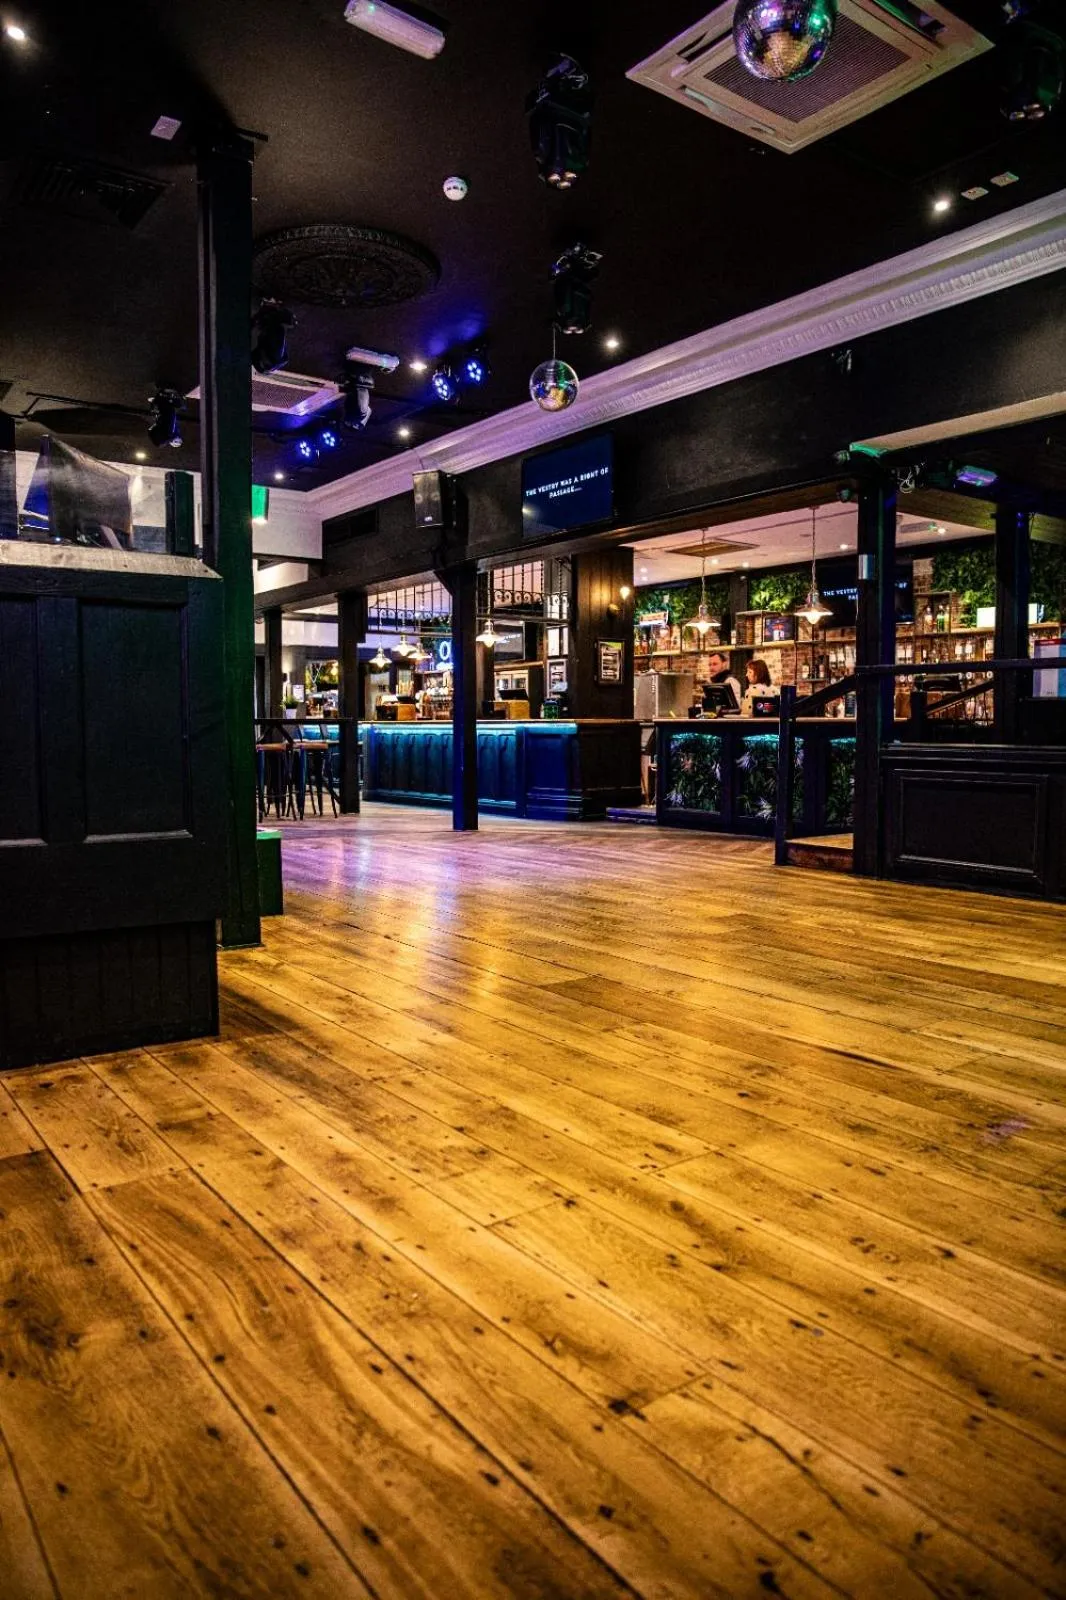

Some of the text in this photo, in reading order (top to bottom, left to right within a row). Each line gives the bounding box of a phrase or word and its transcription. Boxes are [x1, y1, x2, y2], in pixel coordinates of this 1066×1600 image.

[526, 488, 537, 497] THE
[538, 482, 559, 493] VESTRY
[560, 478, 573, 487] WAS
[600, 467, 609, 475] OF
